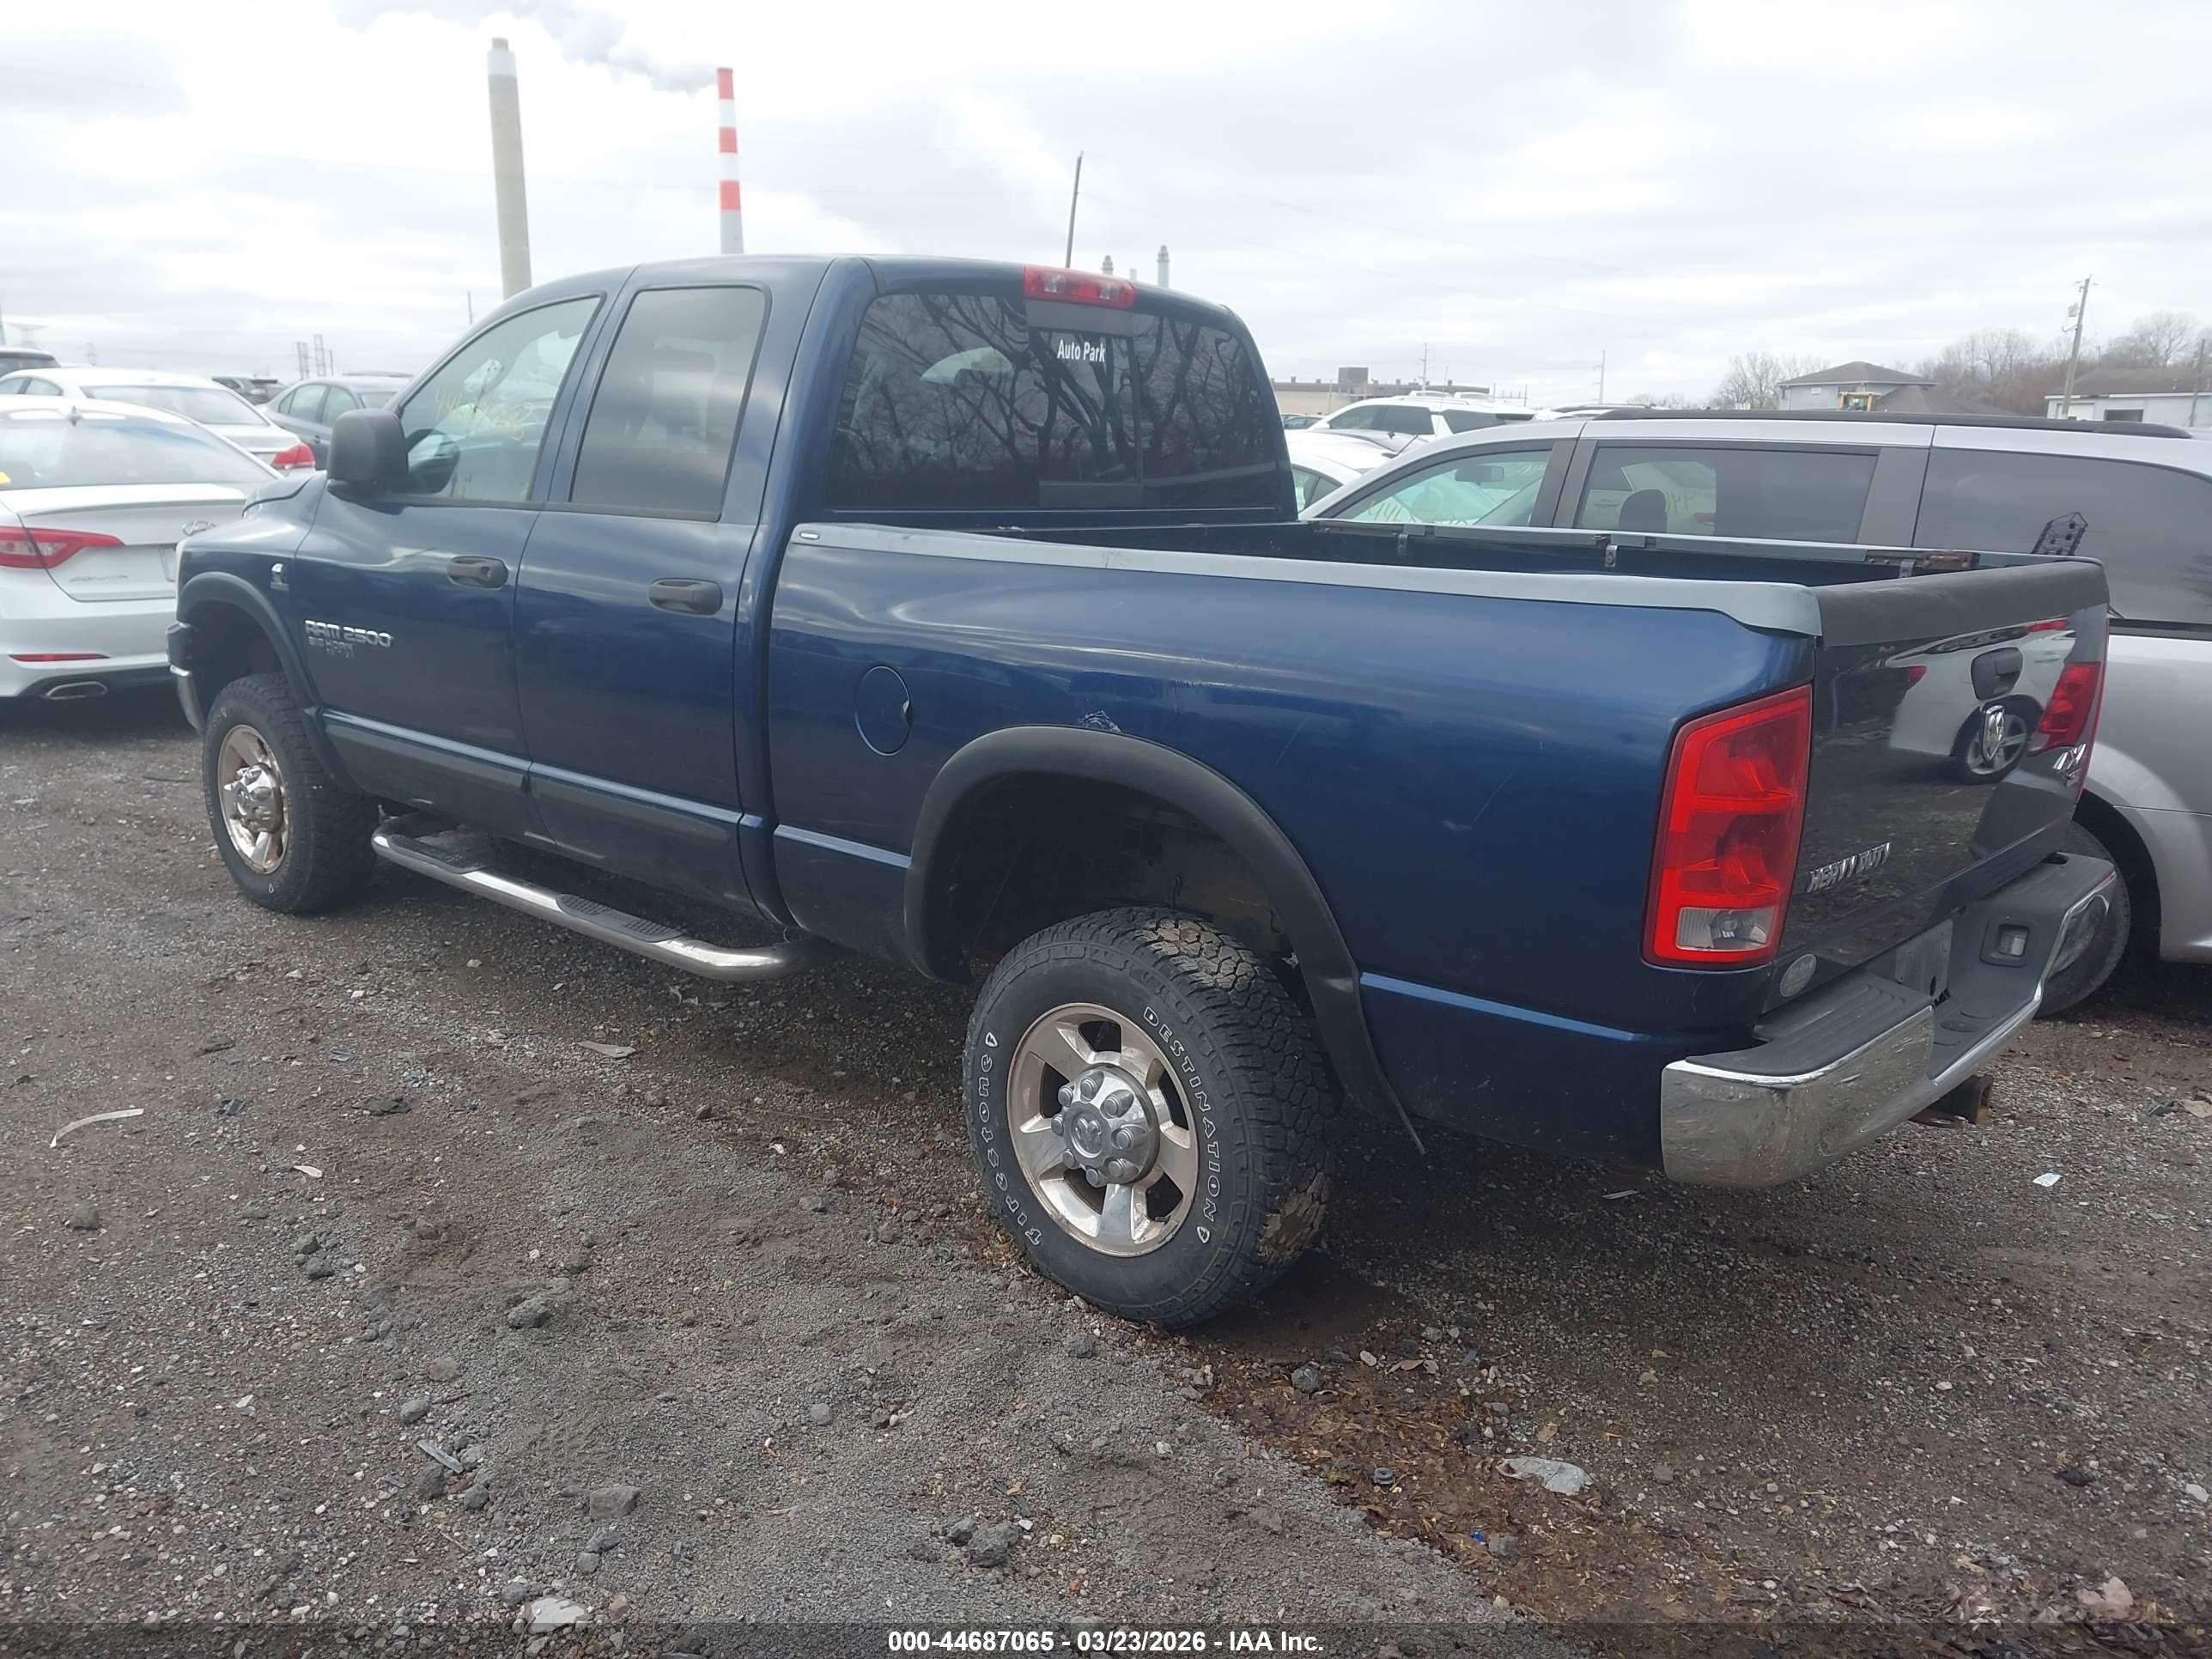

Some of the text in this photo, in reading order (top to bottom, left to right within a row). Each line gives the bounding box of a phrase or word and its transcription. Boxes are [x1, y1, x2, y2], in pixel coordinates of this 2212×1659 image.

[1056, 338, 1106, 362] Auto Park
[343, 626, 392, 648] 2500
[1806, 842, 1891, 894] HEAVY DUTY
[1143, 1006, 1222, 1224] DESTINATION
[977, 1053, 1043, 1246] Firestone
